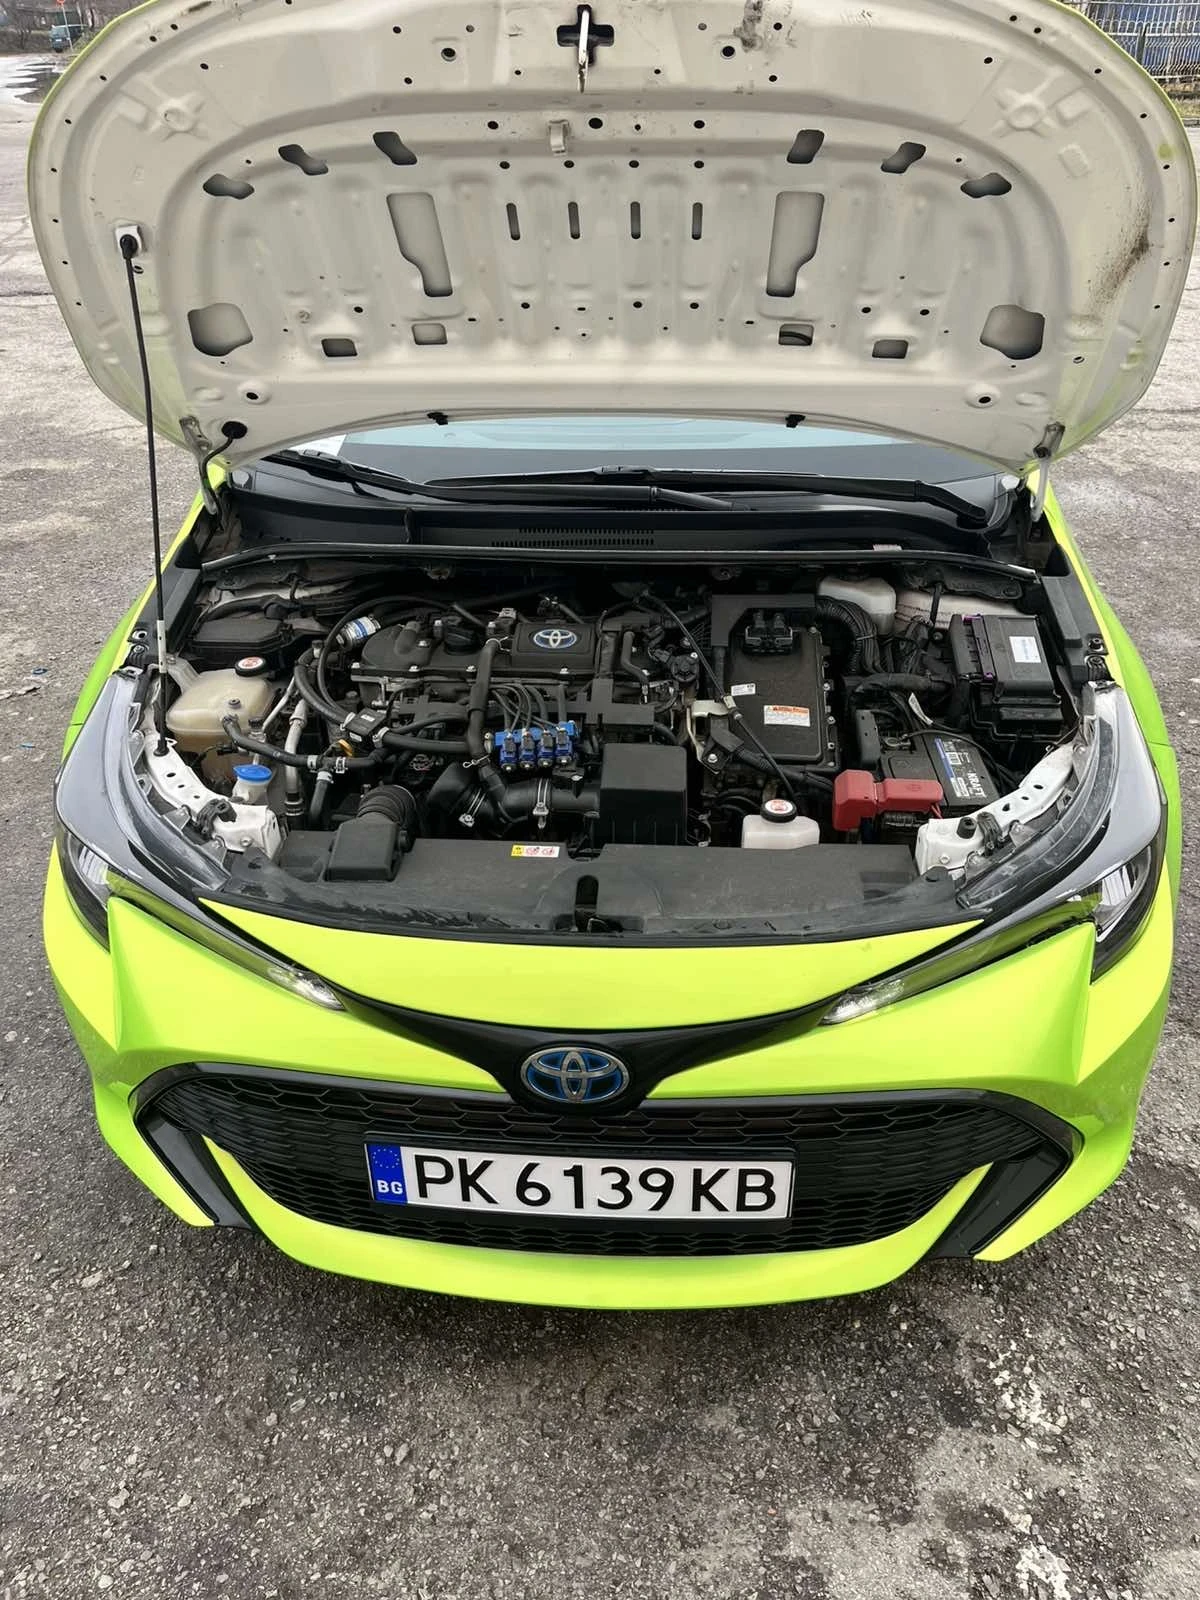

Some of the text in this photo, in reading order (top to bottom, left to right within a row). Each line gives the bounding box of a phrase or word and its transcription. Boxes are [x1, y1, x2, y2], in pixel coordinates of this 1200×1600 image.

[376, 1180, 404, 1195] BG
[414, 1154, 776, 1212] PK 6139 KB
